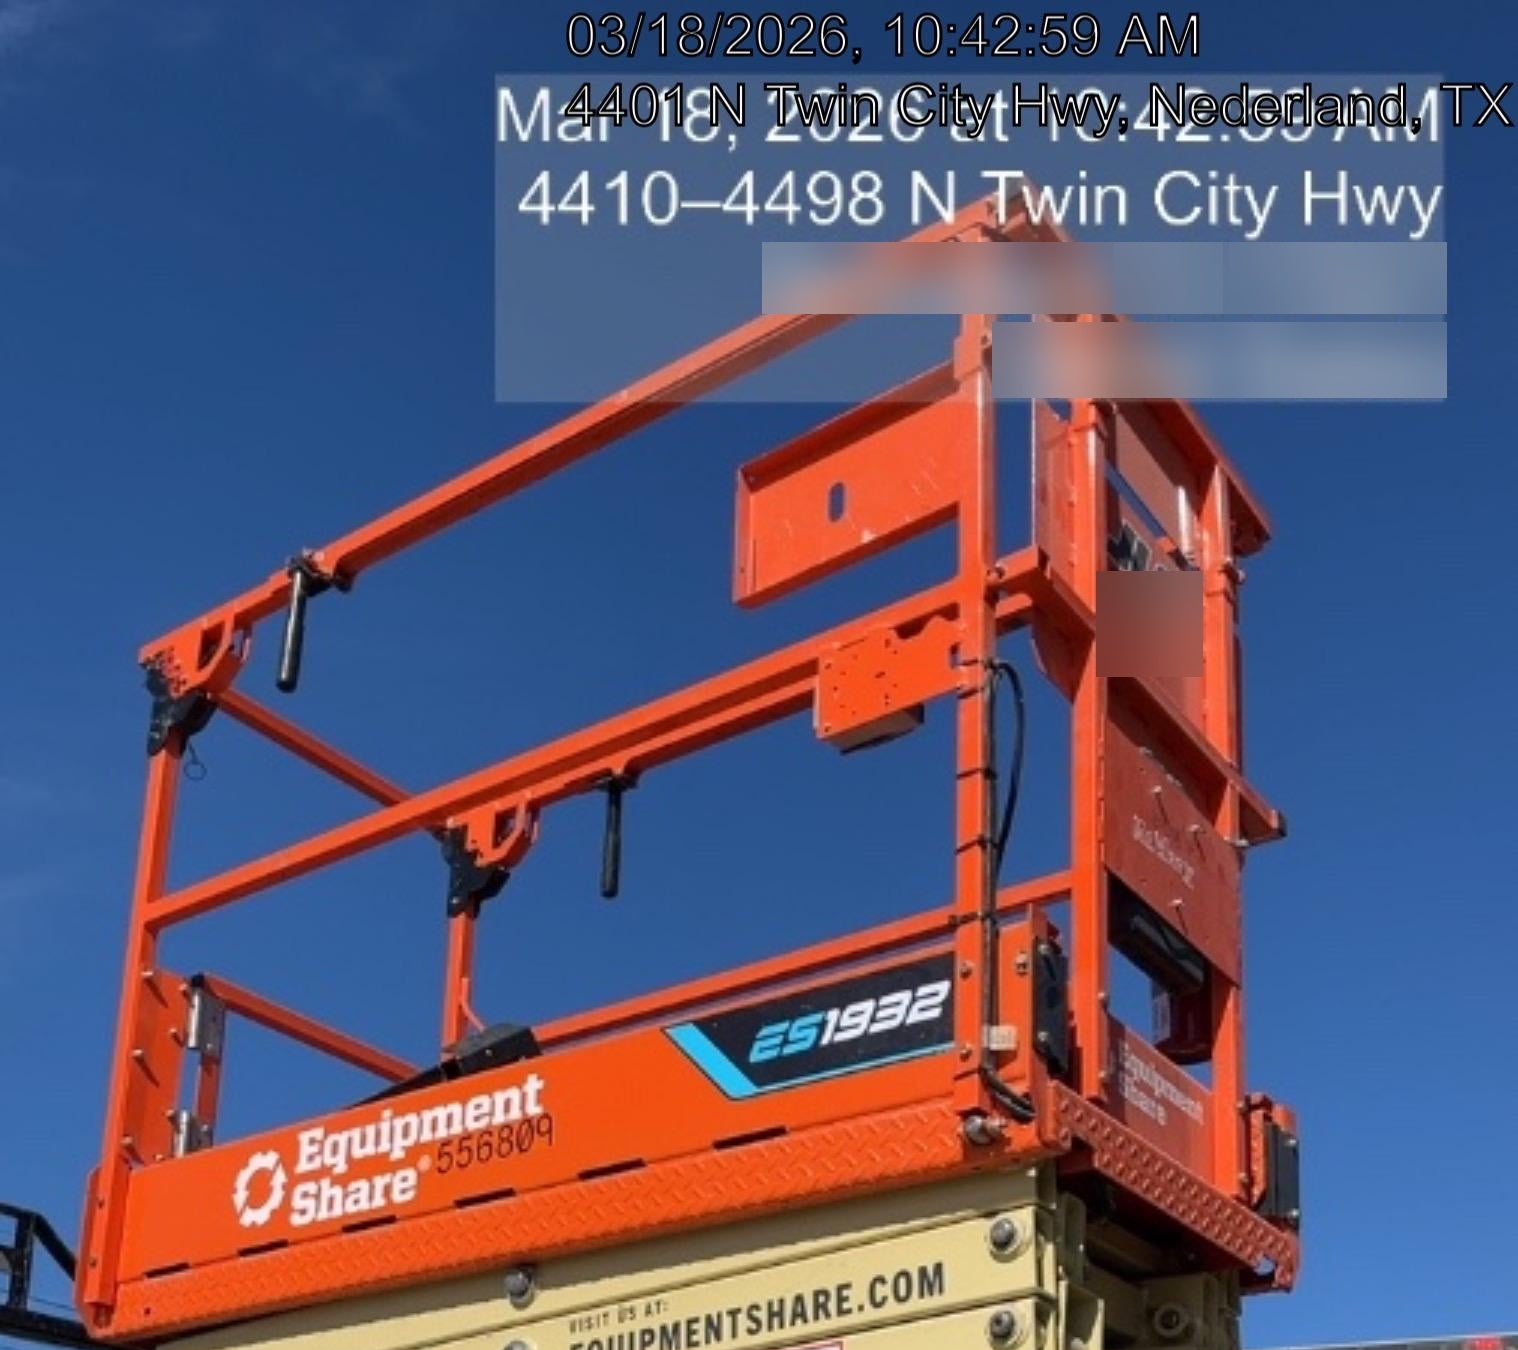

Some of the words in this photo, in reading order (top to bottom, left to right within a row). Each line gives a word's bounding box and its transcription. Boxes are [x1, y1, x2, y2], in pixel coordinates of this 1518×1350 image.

[749, 980, 951, 1064] ES1932
[294, 1073, 545, 1176] Equipment
[437, 1112, 554, 1175] 556809
[569, 1313, 610, 1334] VISIT
[617, 1304, 637, 1325] US
[643, 1300, 669, 1320] AT:
